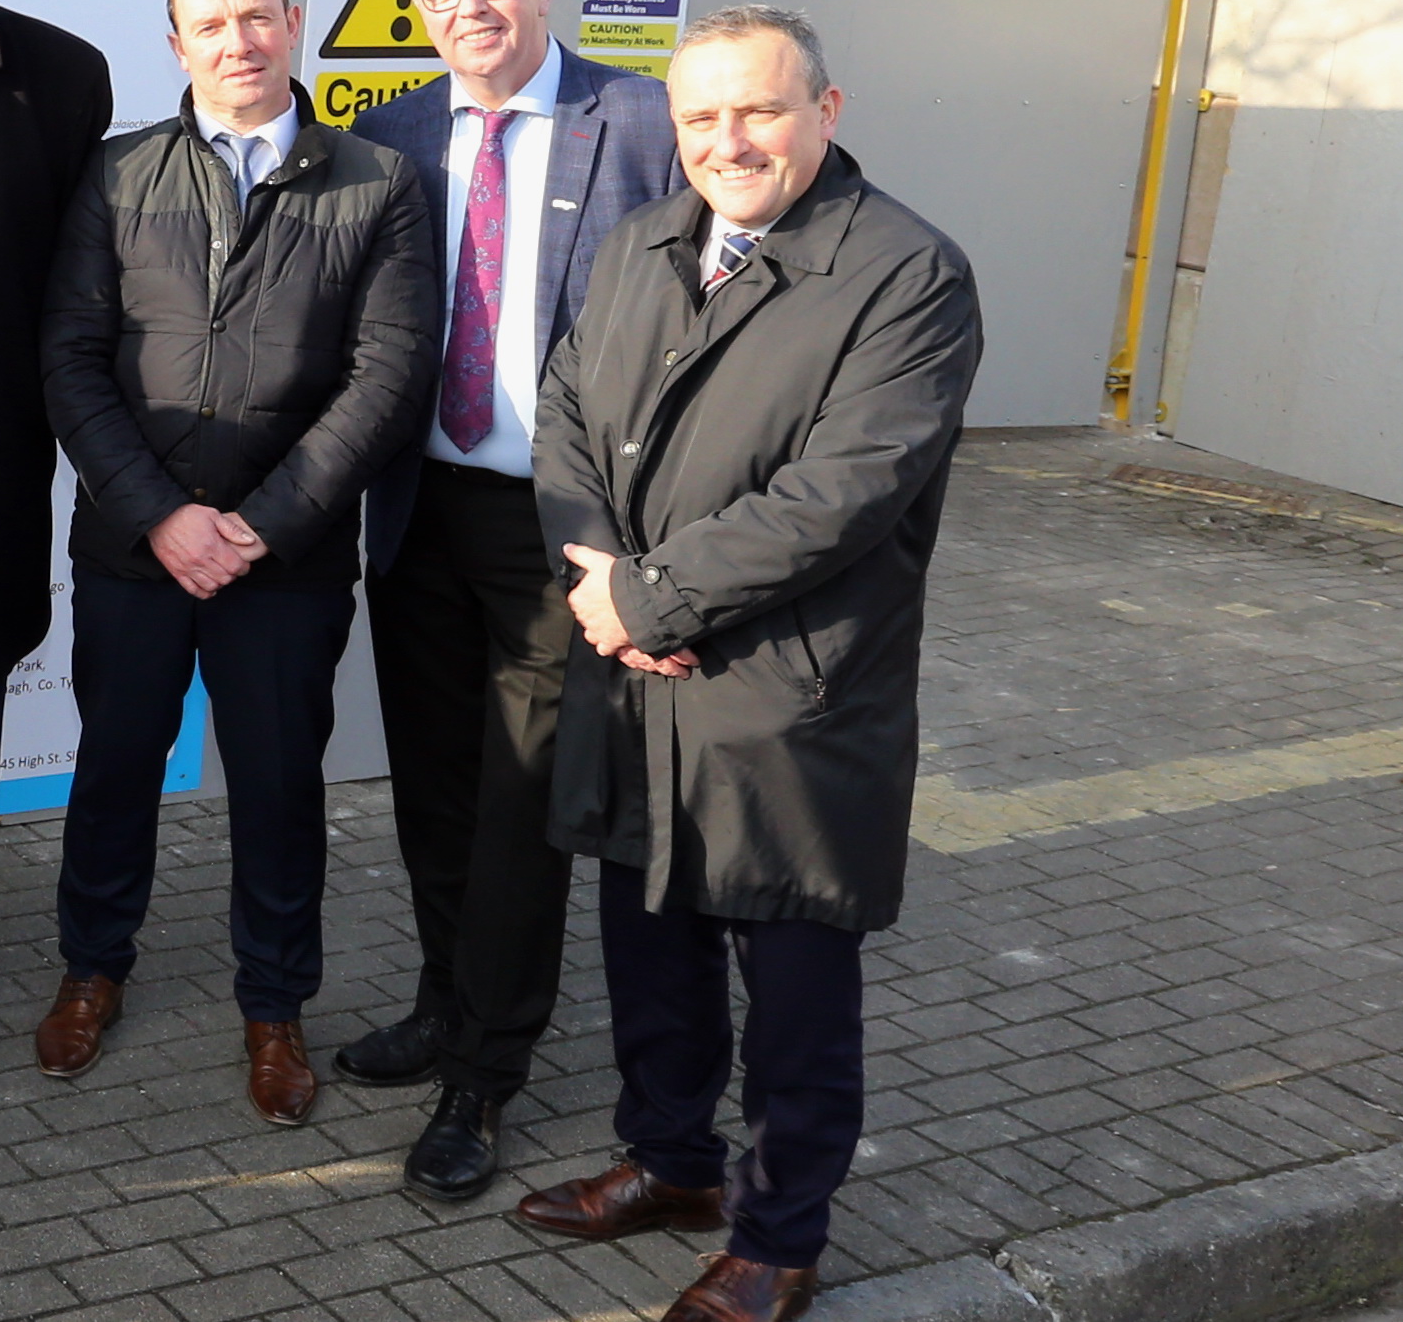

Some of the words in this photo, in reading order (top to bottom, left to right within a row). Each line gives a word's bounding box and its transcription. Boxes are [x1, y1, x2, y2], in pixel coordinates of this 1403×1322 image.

[590, 3, 612, 13] Must
[613, 4, 624, 13] Be
[625, 5, 647, 14] Worn
[589, 24, 644, 34] CAUTION!
[591, 36, 632, 46] Machinery
[644, 38, 665, 46] Work
[38, 679, 57, 690] Co.
[18, 754, 44, 769] High
[47, 753, 62, 765] St.
